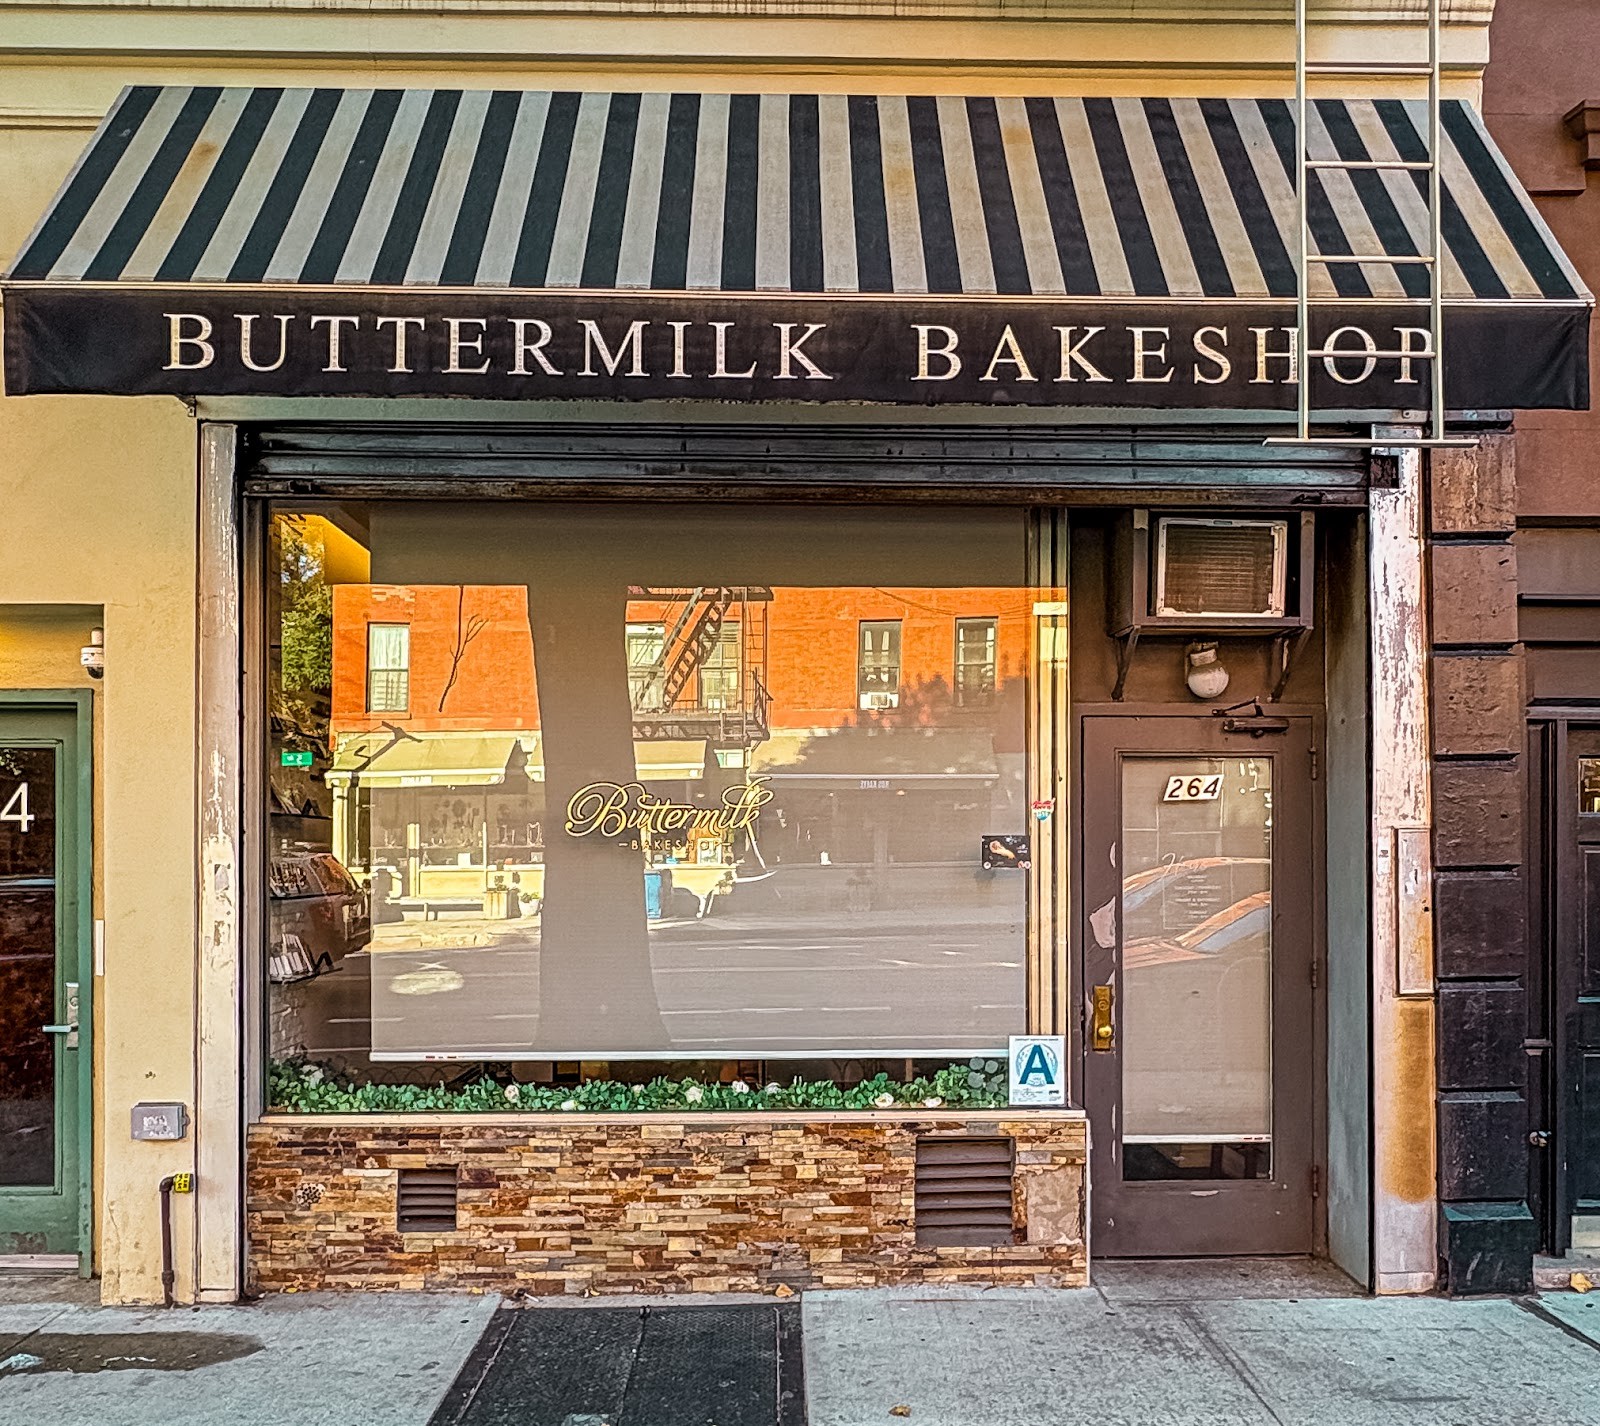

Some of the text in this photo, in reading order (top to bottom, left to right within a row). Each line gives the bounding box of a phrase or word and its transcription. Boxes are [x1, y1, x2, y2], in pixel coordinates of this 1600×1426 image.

[162, 312, 1433, 385] BUTTERMILK BAKESHOP
[0, 781, 35, 833] 4
[564, 776, 774, 838] Buttermilk
[1167, 776, 1220, 798] 264
[630, 839, 720, 851] BAKESHOP
[1018, 1044, 1055, 1085] A
